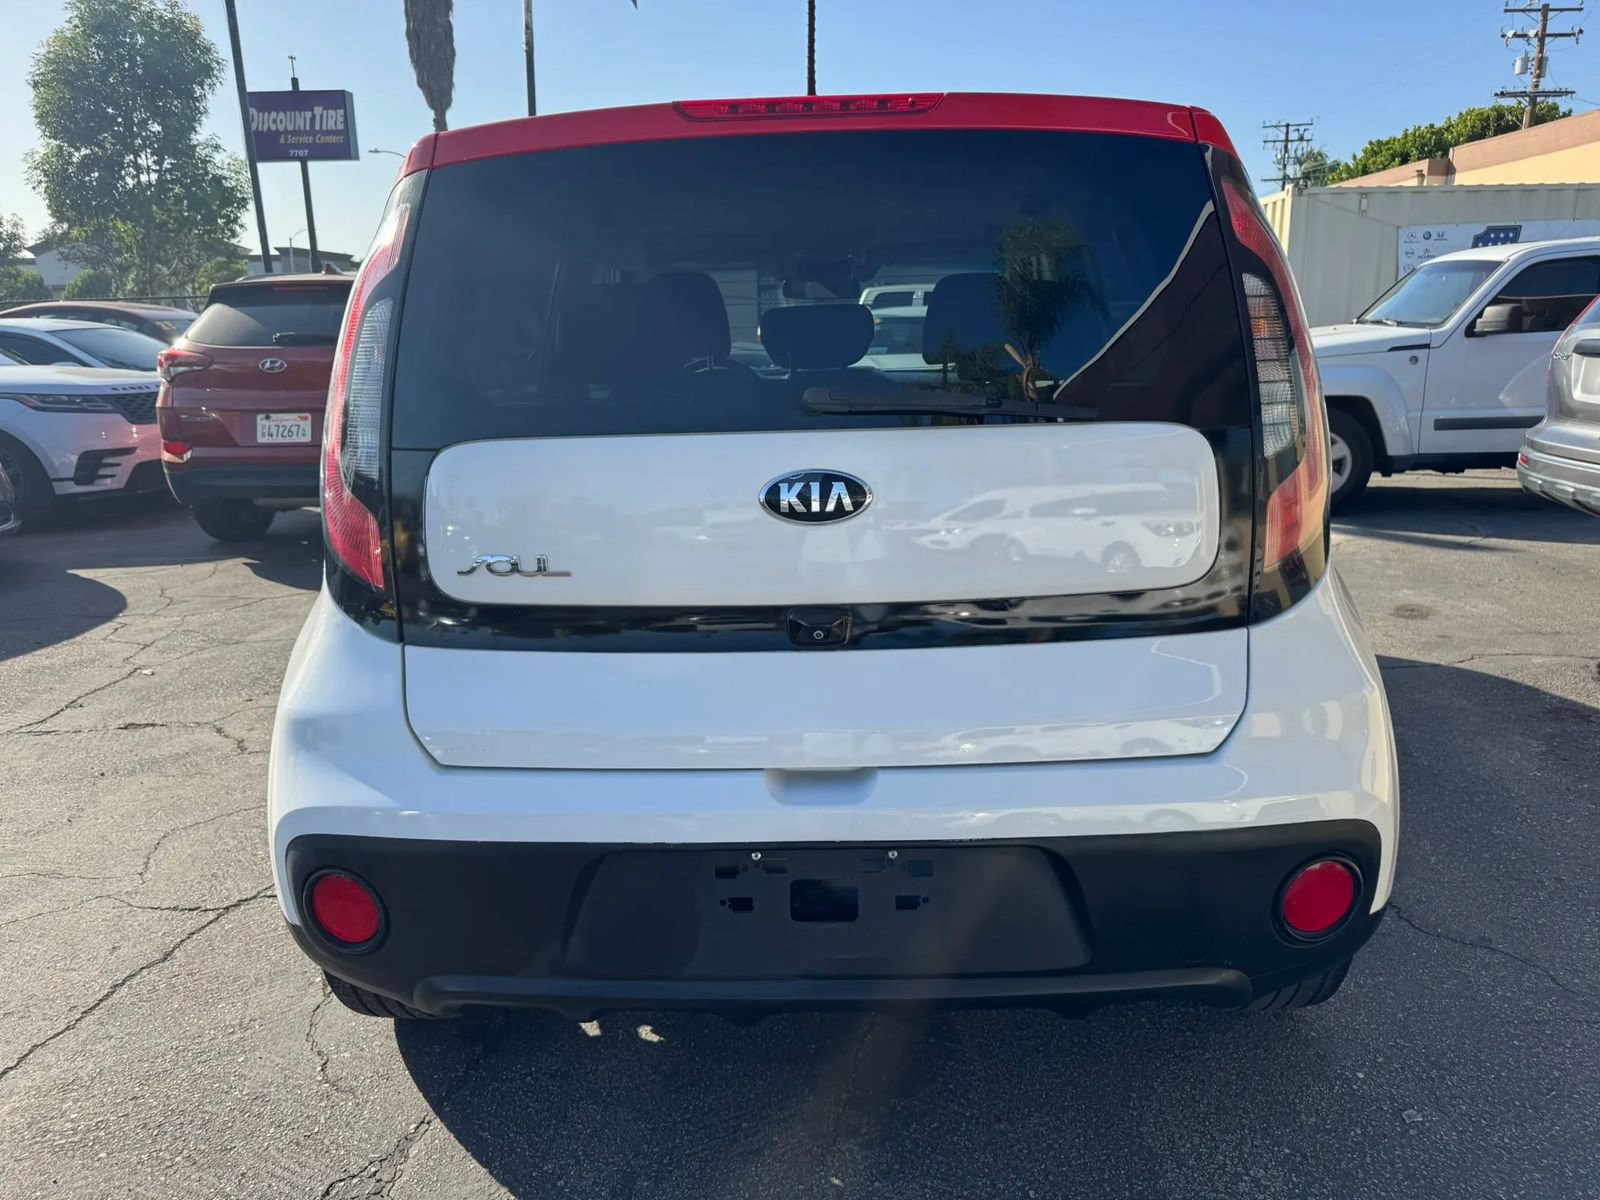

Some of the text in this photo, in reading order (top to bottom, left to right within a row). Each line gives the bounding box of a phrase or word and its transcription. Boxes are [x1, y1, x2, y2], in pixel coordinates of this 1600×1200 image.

[279, 134, 344, 144] & Service Centers
[289, 149, 309, 157] 7707
[778, 481, 854, 513] KIA
[456, 553, 572, 577] SOUL
